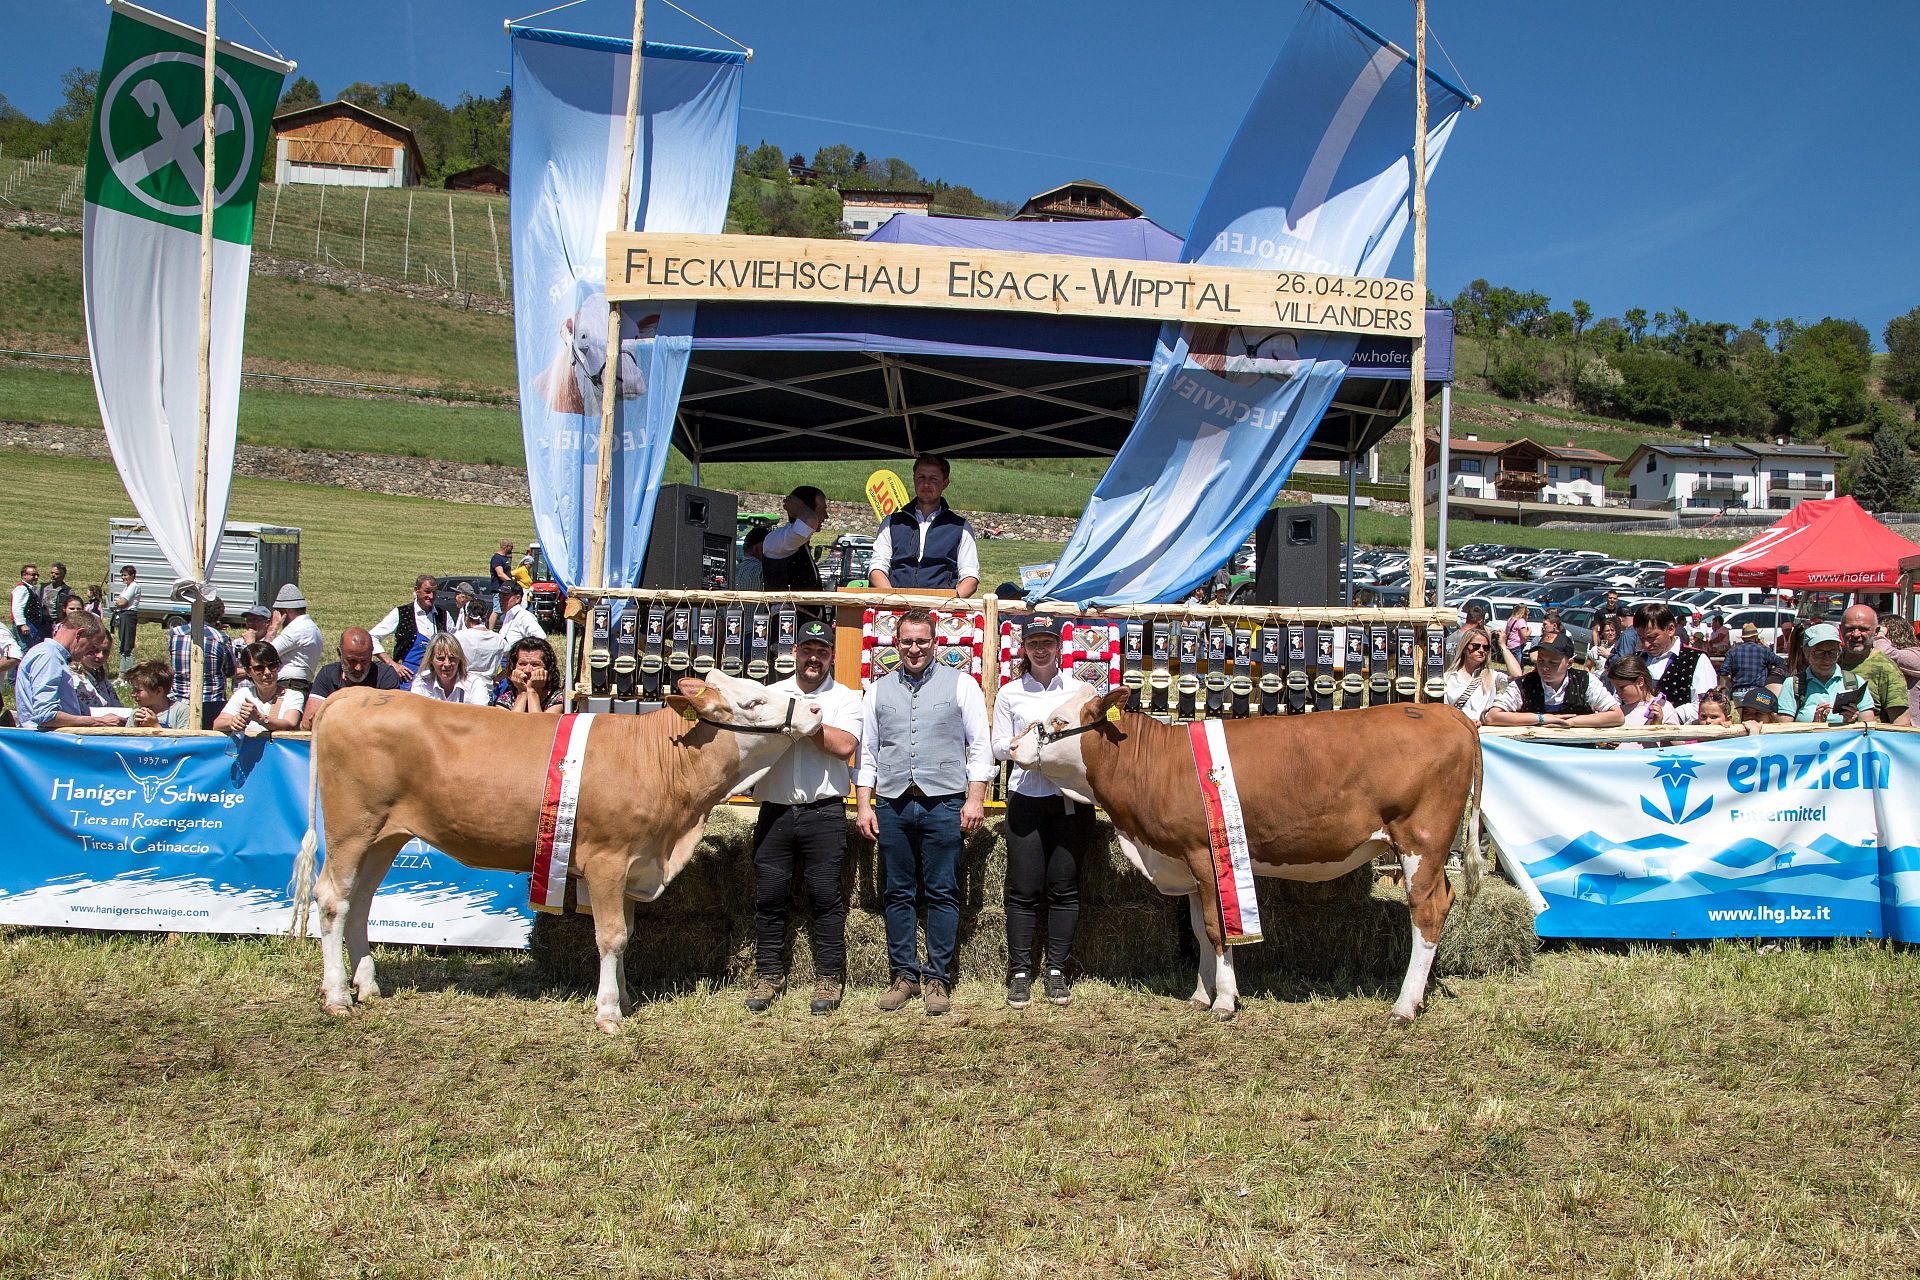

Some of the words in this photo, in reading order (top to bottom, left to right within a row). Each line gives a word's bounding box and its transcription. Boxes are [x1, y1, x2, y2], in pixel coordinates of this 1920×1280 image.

[625, 248, 921, 295] FLECKVIEHSCHAU
[948, 260, 1242, 313] EISACK-WIPPTAL
[1276, 273, 1414, 302] 26.04.2026
[1275, 301, 1413, 331] VILLANDERS
[1352, 349, 1410, 363] w.hofer.
[1808, 571, 1886, 583] www.hofer.it
[138, 756, 159, 765] 1937
[1726, 740, 1891, 794] enzian
[51, 778, 137, 807] Haniger
[160, 785, 245, 809] Schwaige
[70, 809, 108, 827] Tiers
[111, 818, 129, 826] am
[132, 812, 223, 832] Rosengarten
[1730, 805, 1827, 825] Futtermittel
[77, 835, 114, 852] Tires
[117, 836, 128, 851] al
[130, 836, 210, 855] Catinaccio
[391, 854, 432, 870] EZZA
[70, 904, 210, 918] www.hanigerschwaige.com
[1707, 904, 1831, 926] www.lhg.bz.it
[367, 918, 435, 930] w.masare.eu
